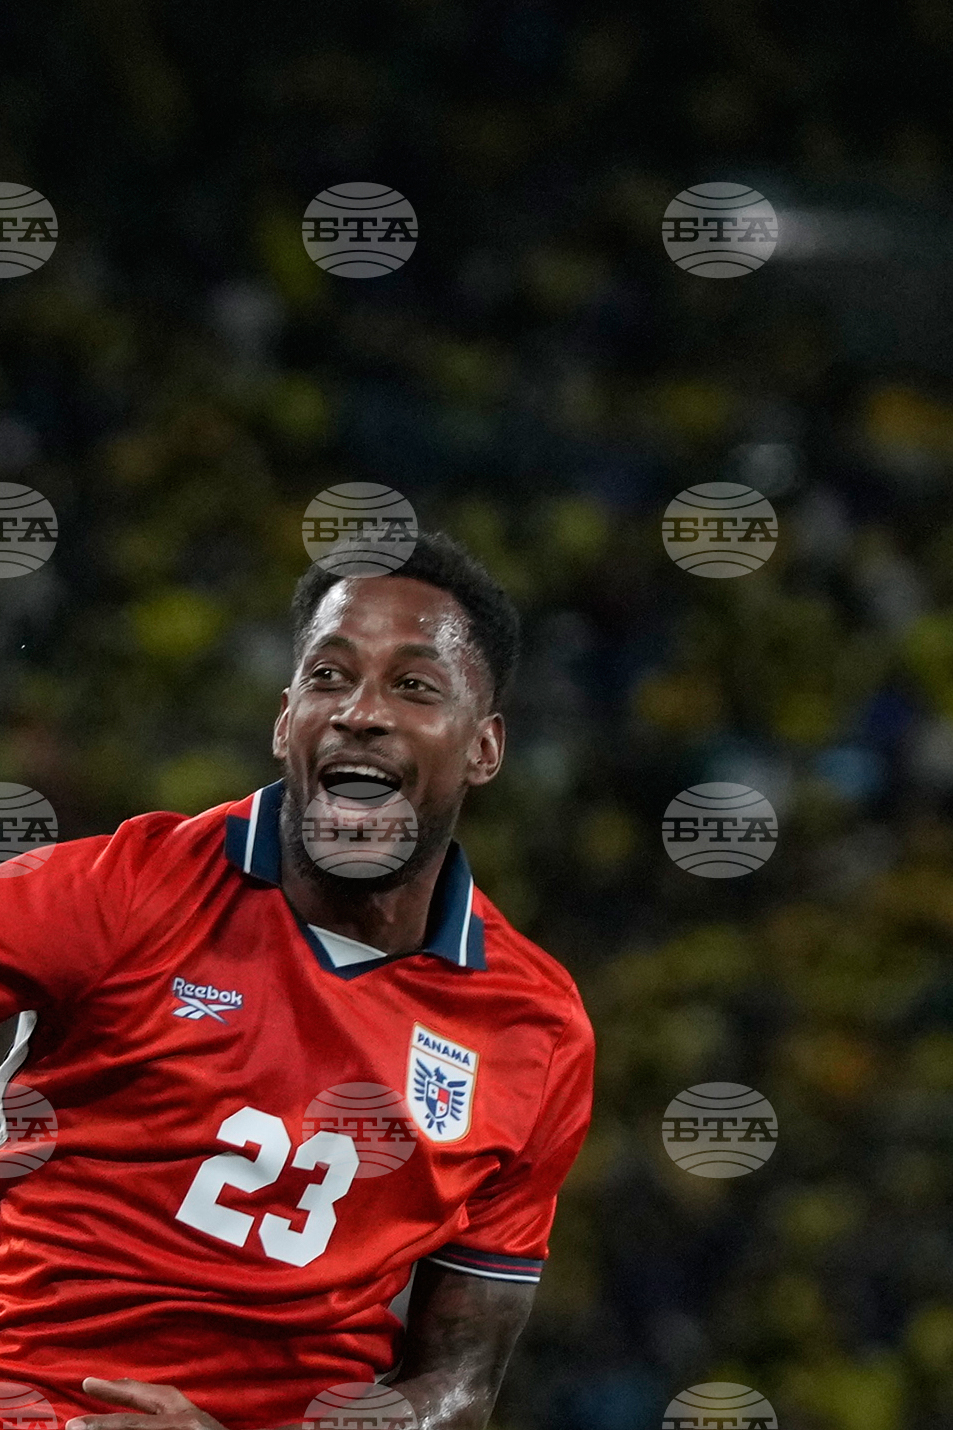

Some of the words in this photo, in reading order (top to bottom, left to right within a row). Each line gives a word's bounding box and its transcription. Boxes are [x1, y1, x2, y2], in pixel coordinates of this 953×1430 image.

[172, 977, 244, 1006] Reebok
[417, 1031, 471, 1067] PANAMÁ
[175, 1105, 360, 1268] 23
